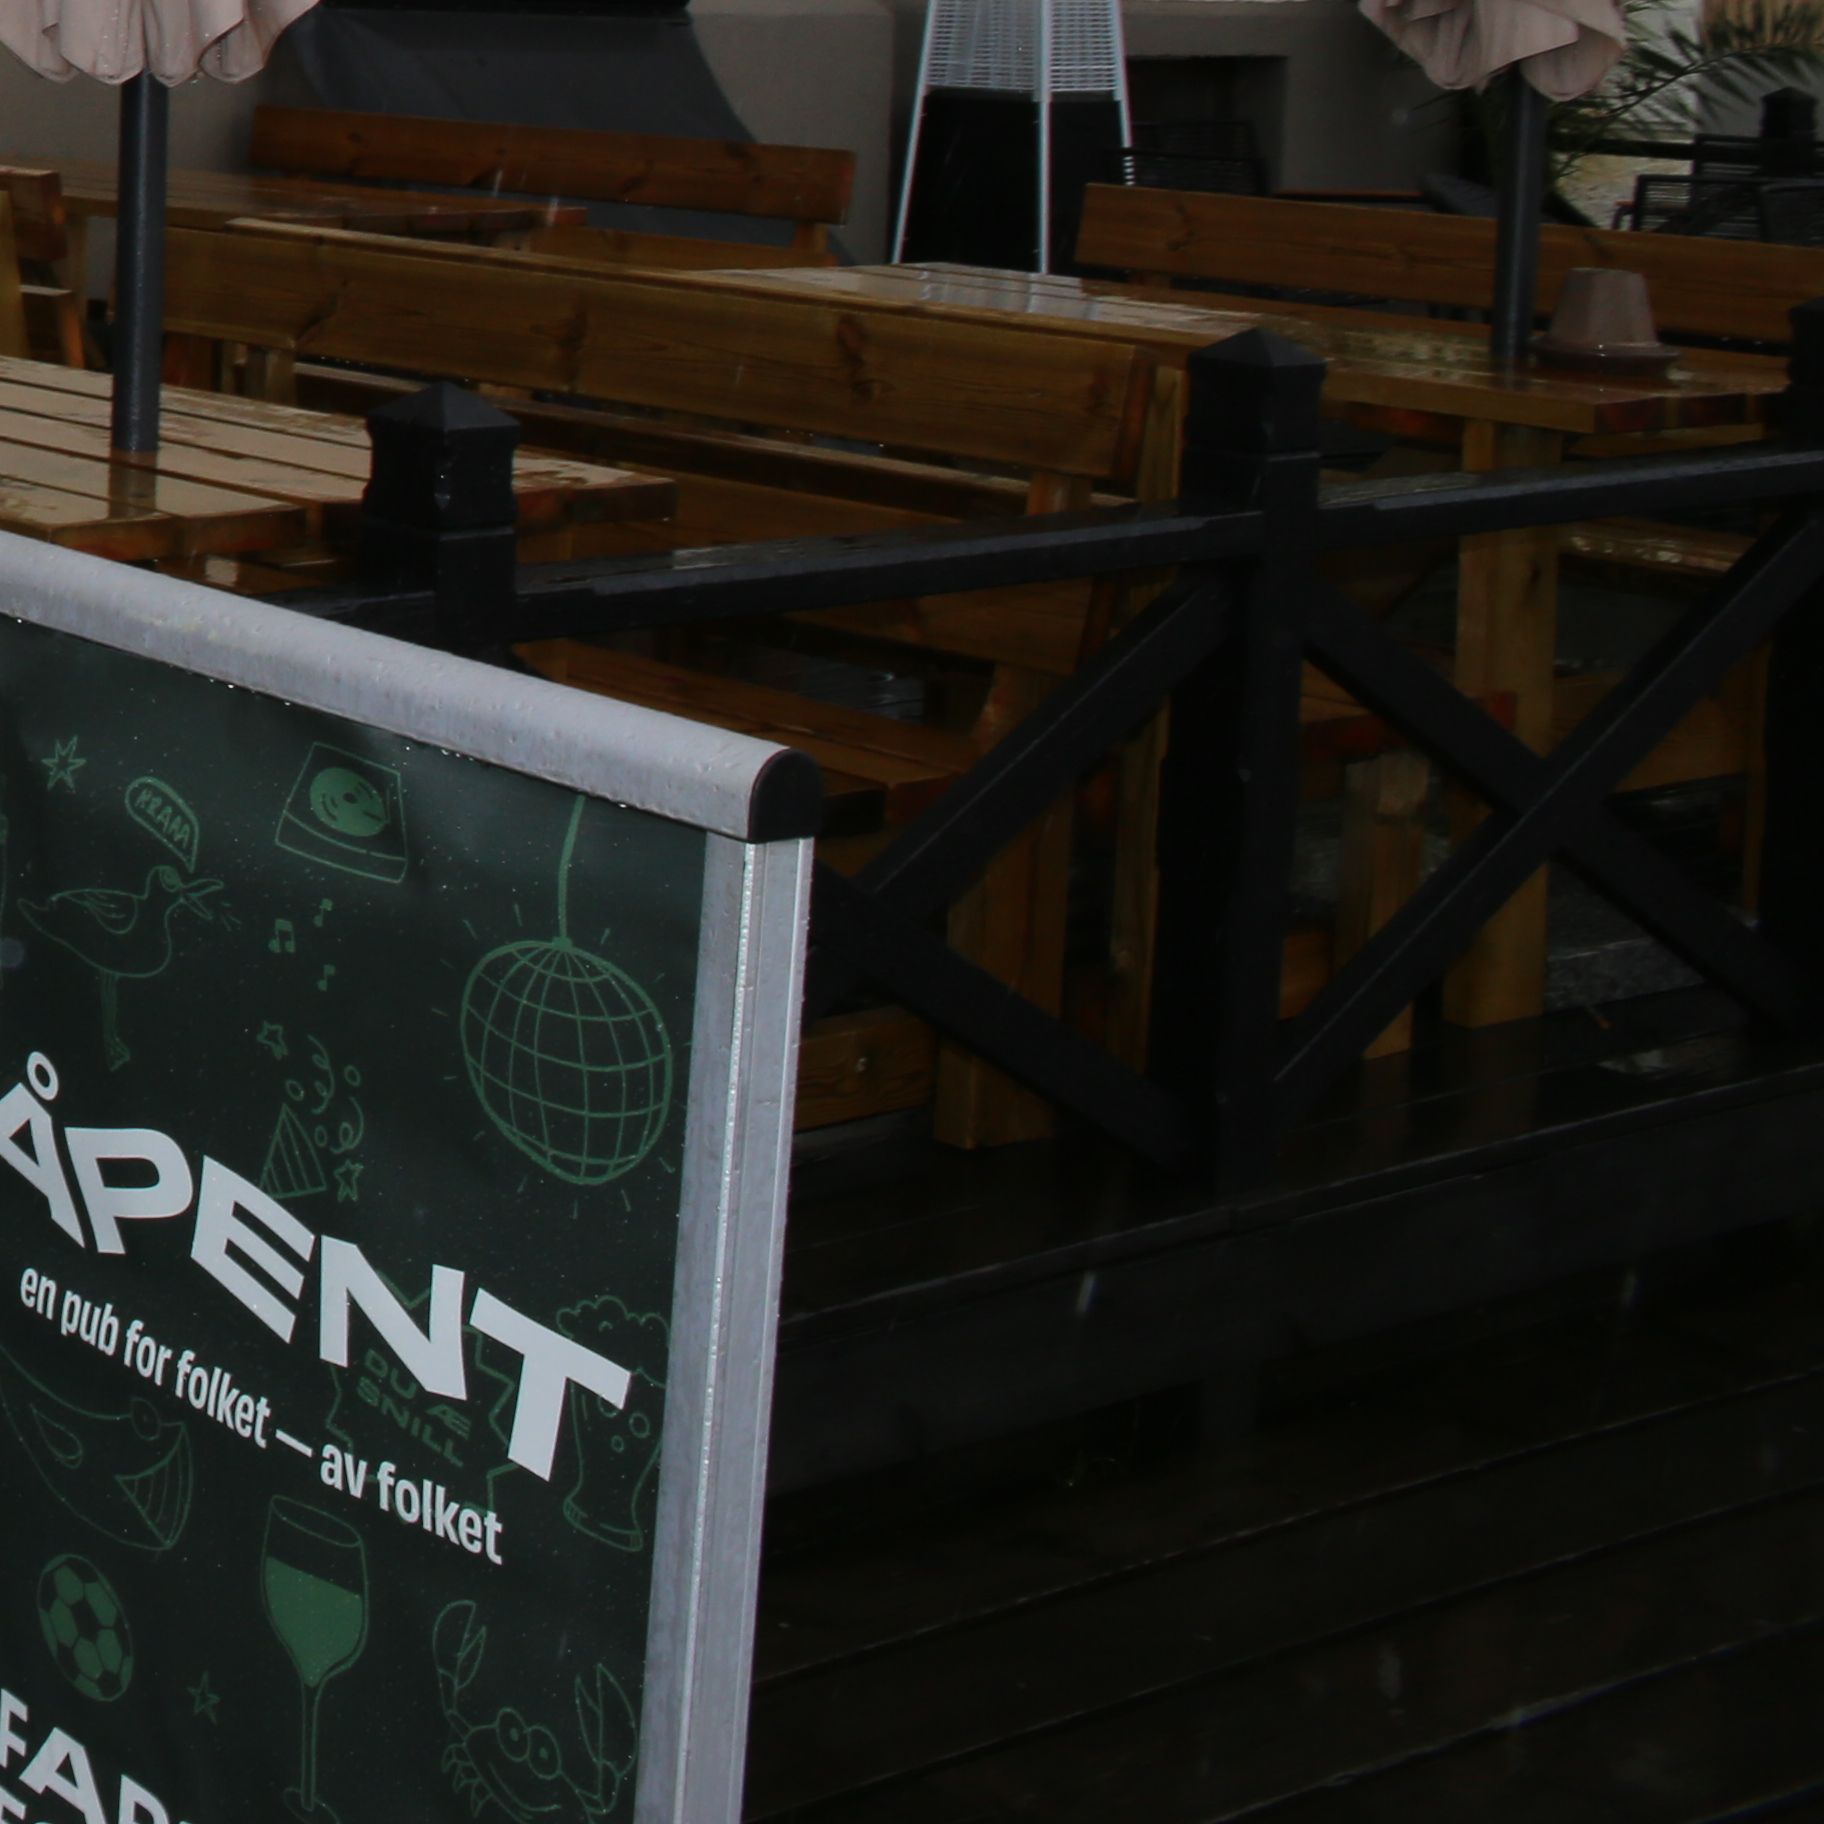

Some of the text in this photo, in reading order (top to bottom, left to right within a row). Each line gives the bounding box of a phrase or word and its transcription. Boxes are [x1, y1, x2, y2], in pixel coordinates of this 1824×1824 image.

[19, 1267, 57, 1320] en
[60, 1289, 119, 1356] pub
[123, 1319, 172, 1387] for
[174, 1349, 271, 1448] folket
[320, 1443, 368, 1499] av
[376, 1460, 503, 1565] folket
[356, 1376, 464, 1468] SNILL
